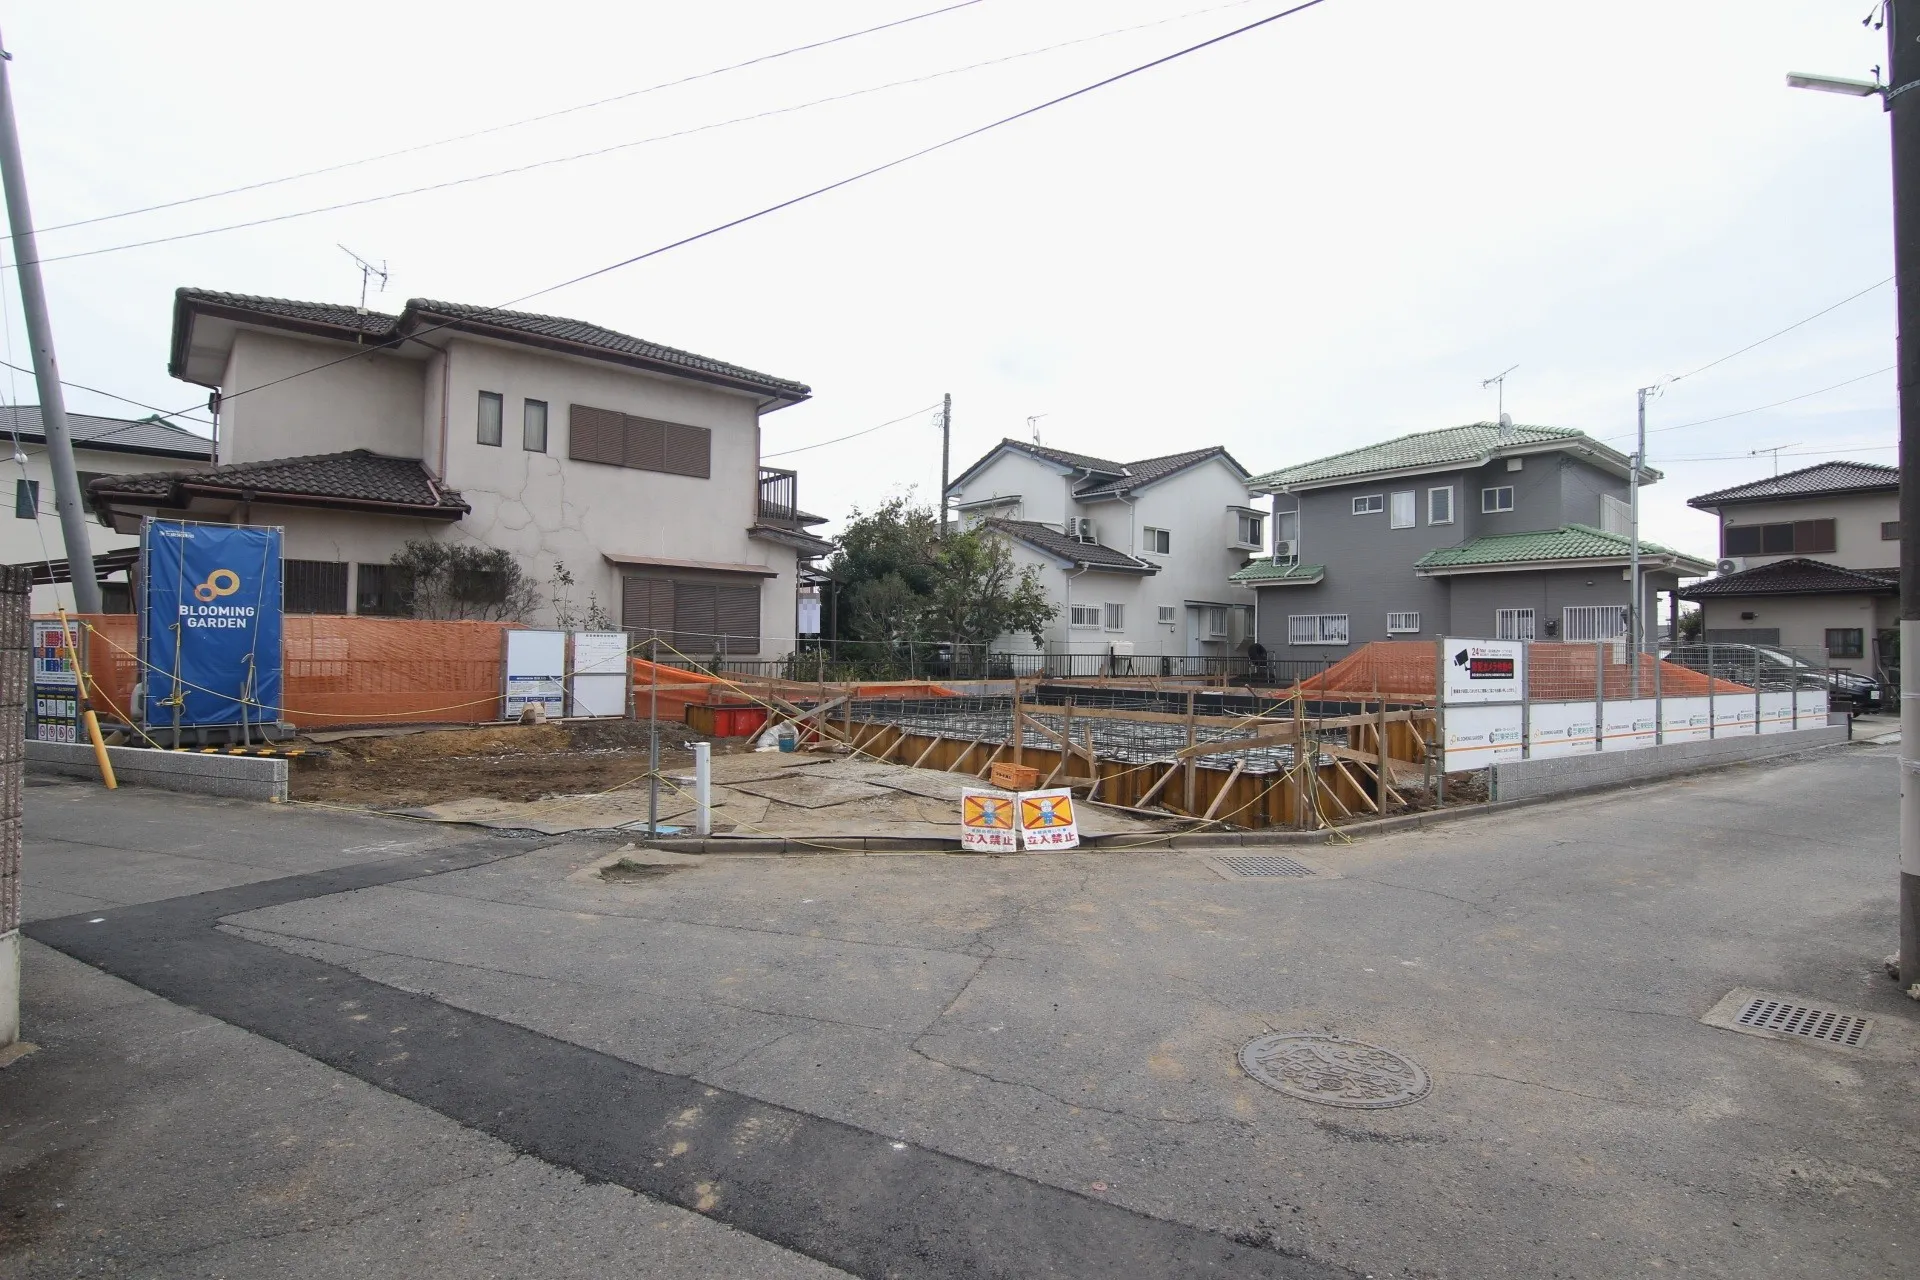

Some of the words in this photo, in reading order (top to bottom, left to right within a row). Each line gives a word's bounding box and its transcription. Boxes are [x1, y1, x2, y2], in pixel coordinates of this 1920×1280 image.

[180, 605, 255, 617] BLOOMING
[187, 617, 247, 628] GARDEN
[1471, 647, 1479, 656] 24
[964, 832, 1014, 846] 立入禁止
[1027, 832, 1076, 845] 立入禁止
